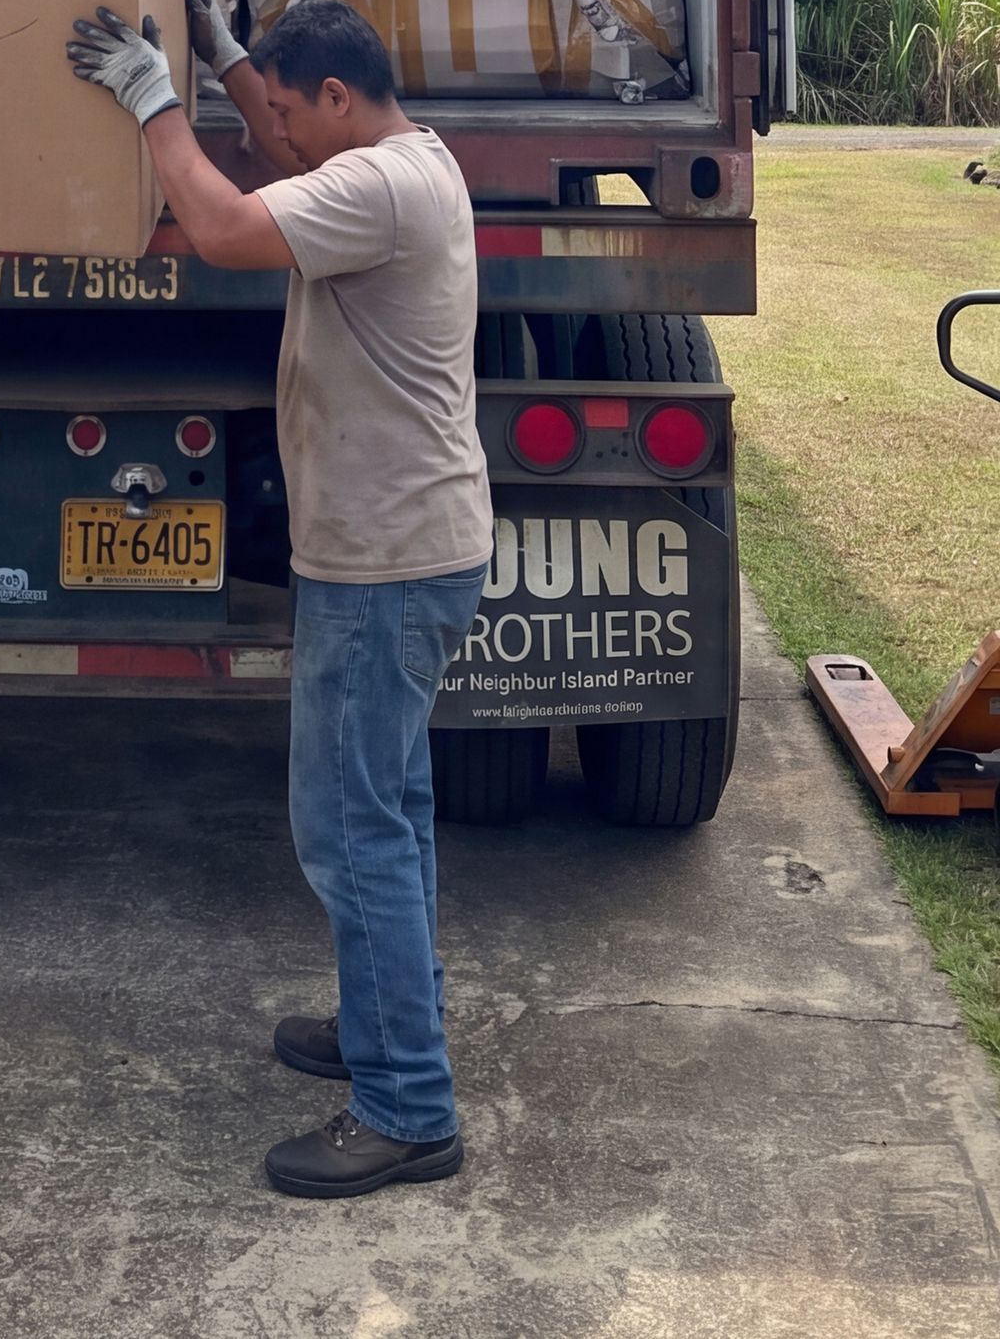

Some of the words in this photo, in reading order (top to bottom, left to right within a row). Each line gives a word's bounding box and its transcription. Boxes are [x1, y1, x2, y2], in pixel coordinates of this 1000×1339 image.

[78, 520, 212, 566] TR-6405
[451, 609, 693, 662] ROTHERS
[469, 672, 556, 696] Neighbur
[561, 670, 618, 689] Island
[623, 668, 695, 687] Partner
